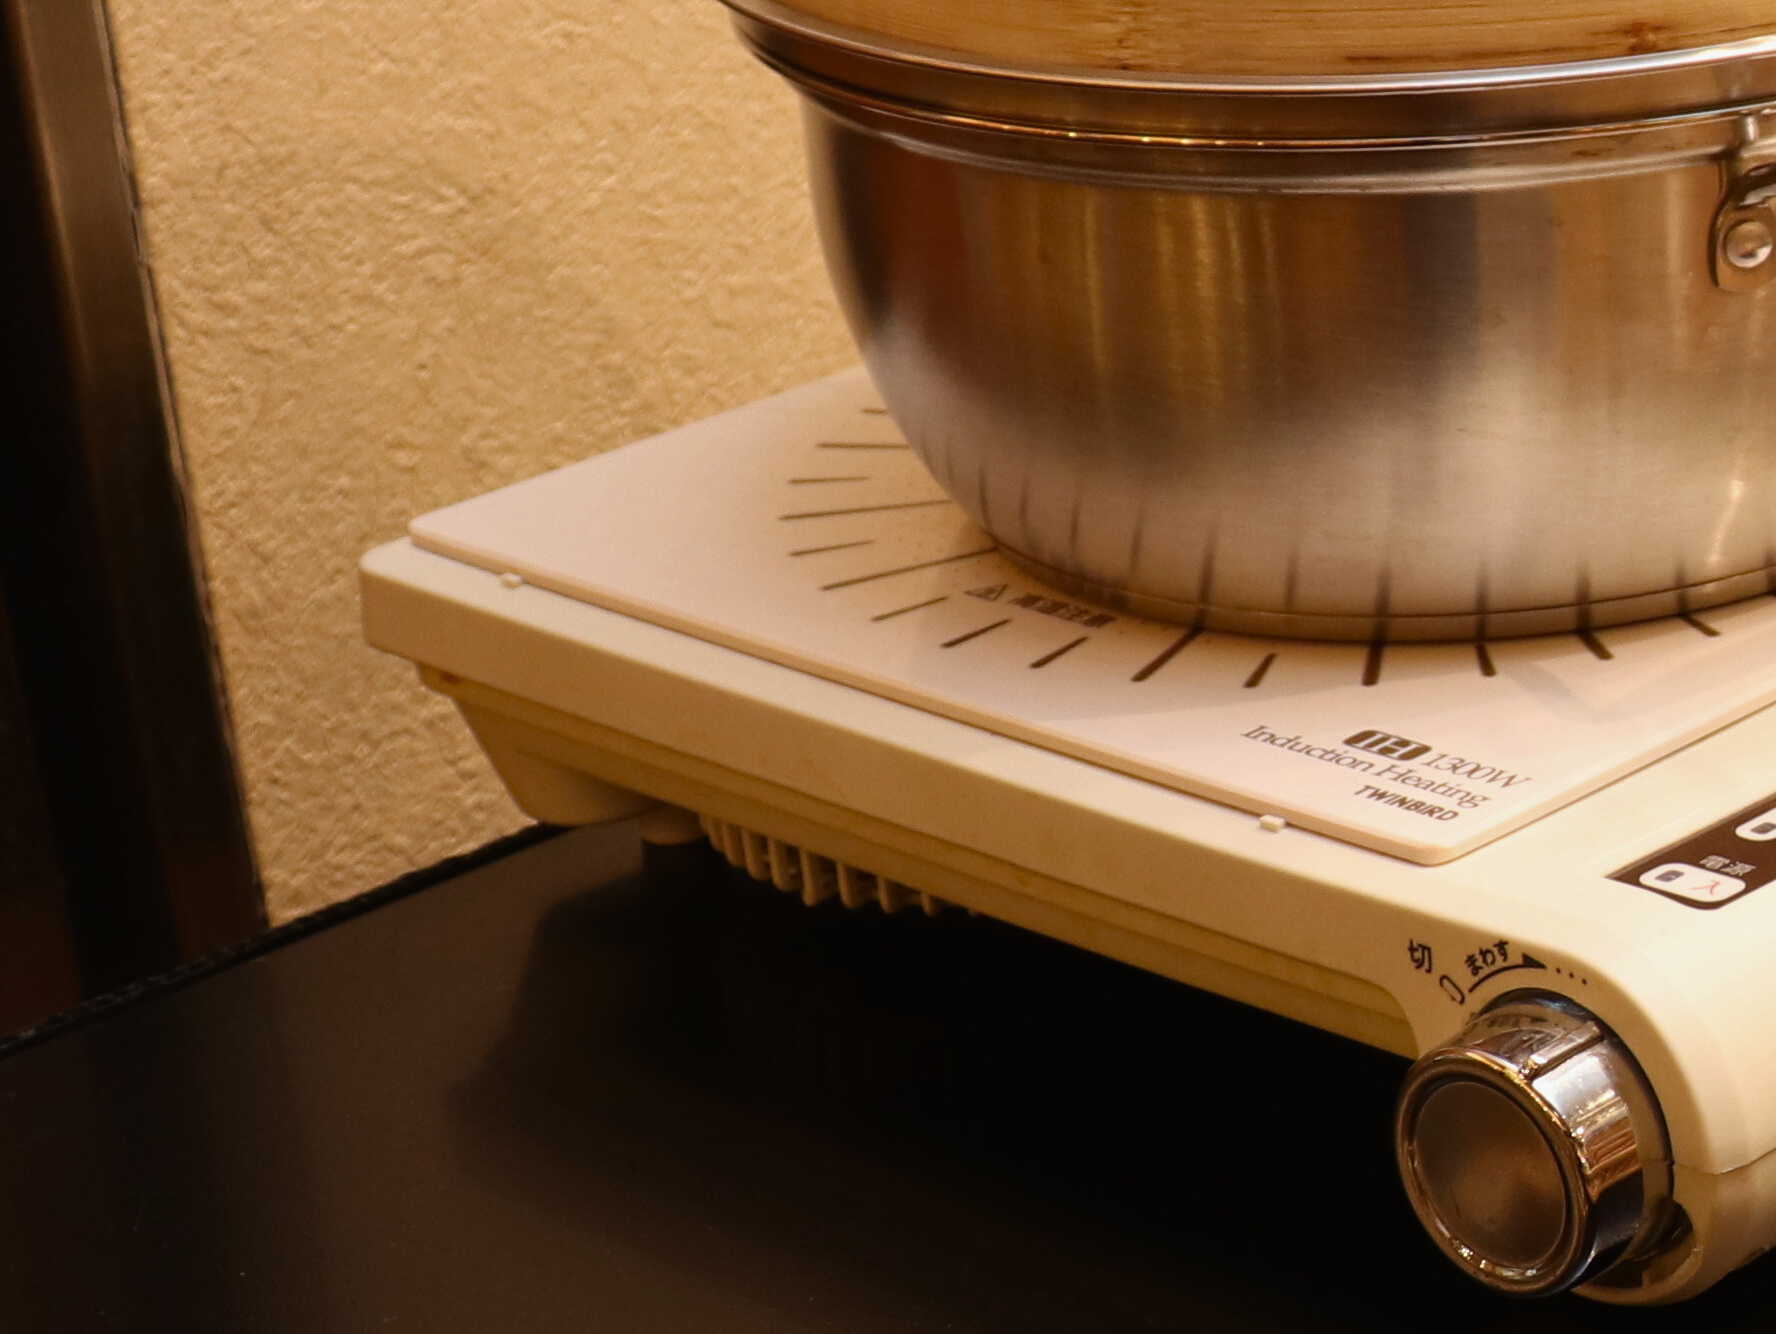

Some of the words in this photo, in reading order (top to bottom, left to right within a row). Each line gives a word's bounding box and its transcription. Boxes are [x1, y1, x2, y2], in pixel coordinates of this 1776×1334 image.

[1240, 724, 1375, 774] Induction
[1374, 762, 1493, 810] Heating
[1420, 752, 1533, 790] 1300W
[1354, 784, 1461, 822] TWINBIRD
[1407, 939, 1433, 974] 切
[1464, 939, 1510, 977] まわす
